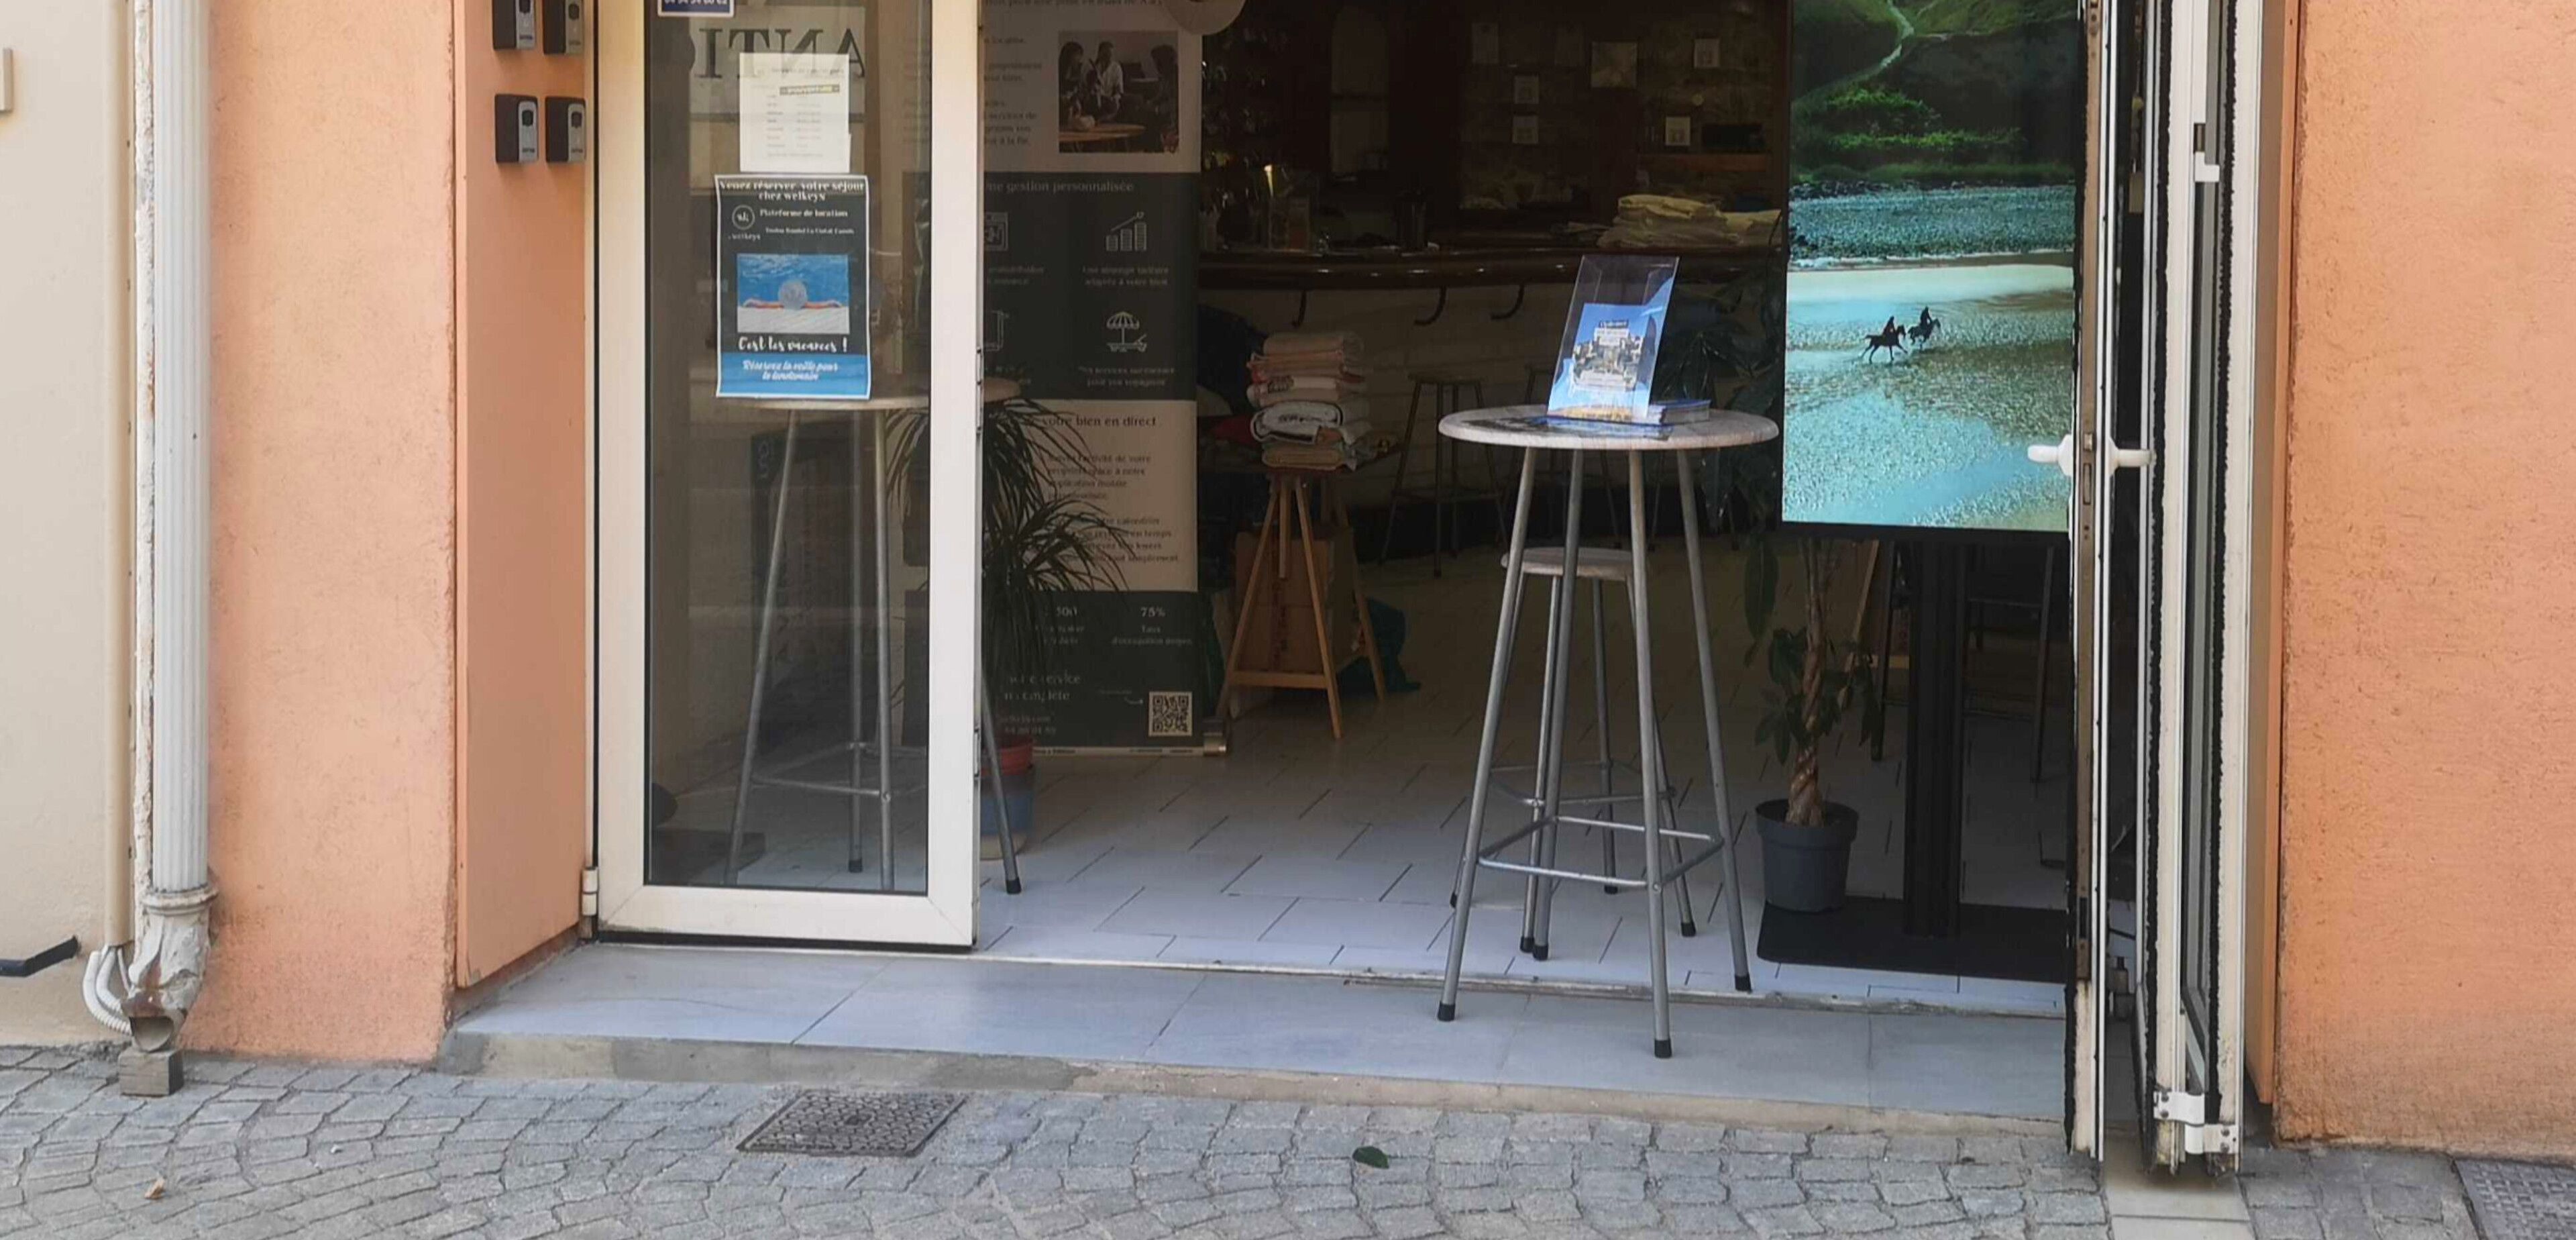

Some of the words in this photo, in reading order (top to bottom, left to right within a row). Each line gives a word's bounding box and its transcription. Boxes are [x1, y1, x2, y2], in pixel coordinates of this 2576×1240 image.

[720, 180, 751, 190] Venez
[754, 180, 795, 190] réserver
[801, 180, 830, 190] votre
[832, 180, 865, 193] séjour
[1006, 180, 1049, 194] gestion
[1053, 180, 1134, 195] personnalisée
[759, 191, 782, 201] chez
[784, 191, 826, 203] welkeys
[760, 209, 802, 217] Plateforme
[804, 209, 813, 217] de
[788, 340, 837, 353] vacances
[843, 337, 848, 353] !
[1075, 413, 1101, 427] bien
[1104, 417, 1120, 427] en
[1122, 414, 1157, 427] direct
[1140, 606, 1166, 618] 75%
